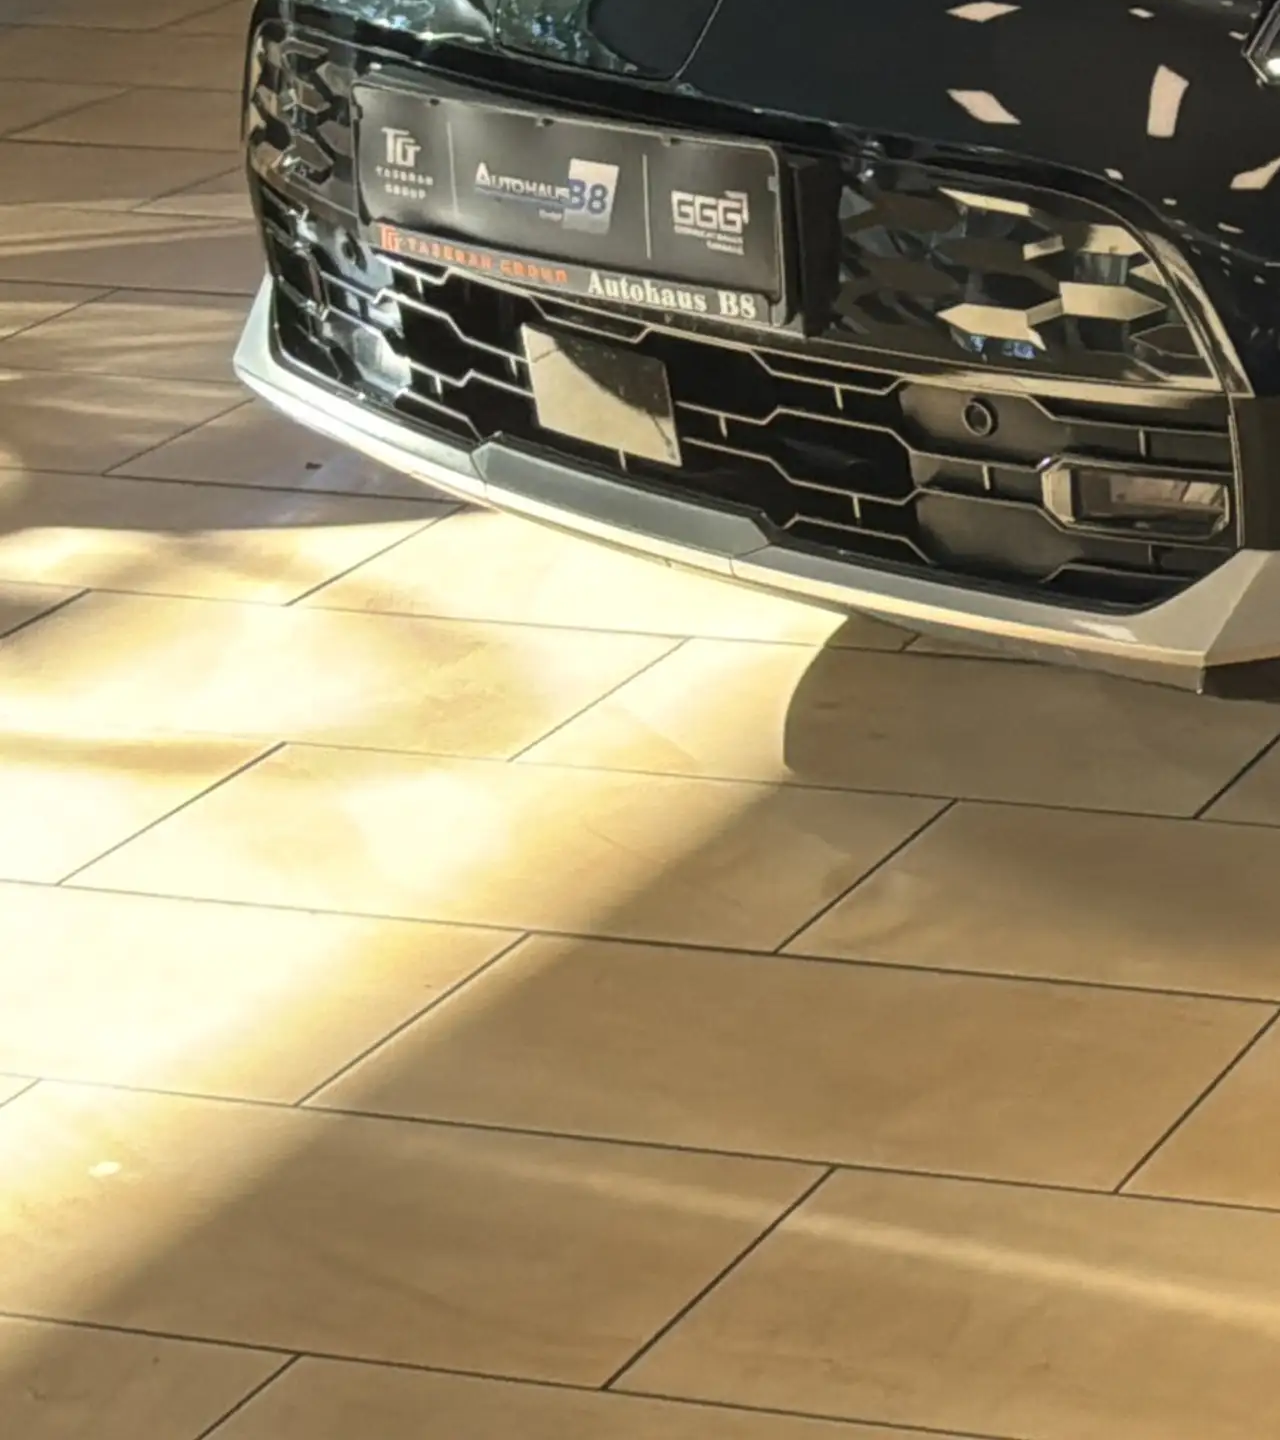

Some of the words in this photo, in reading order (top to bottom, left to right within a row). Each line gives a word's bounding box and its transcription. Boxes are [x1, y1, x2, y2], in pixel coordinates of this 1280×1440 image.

[567, 178, 608, 215] B8
[670, 189, 749, 234] GGG
[587, 271, 707, 312] Autohaus
[717, 290, 757, 319] B8
